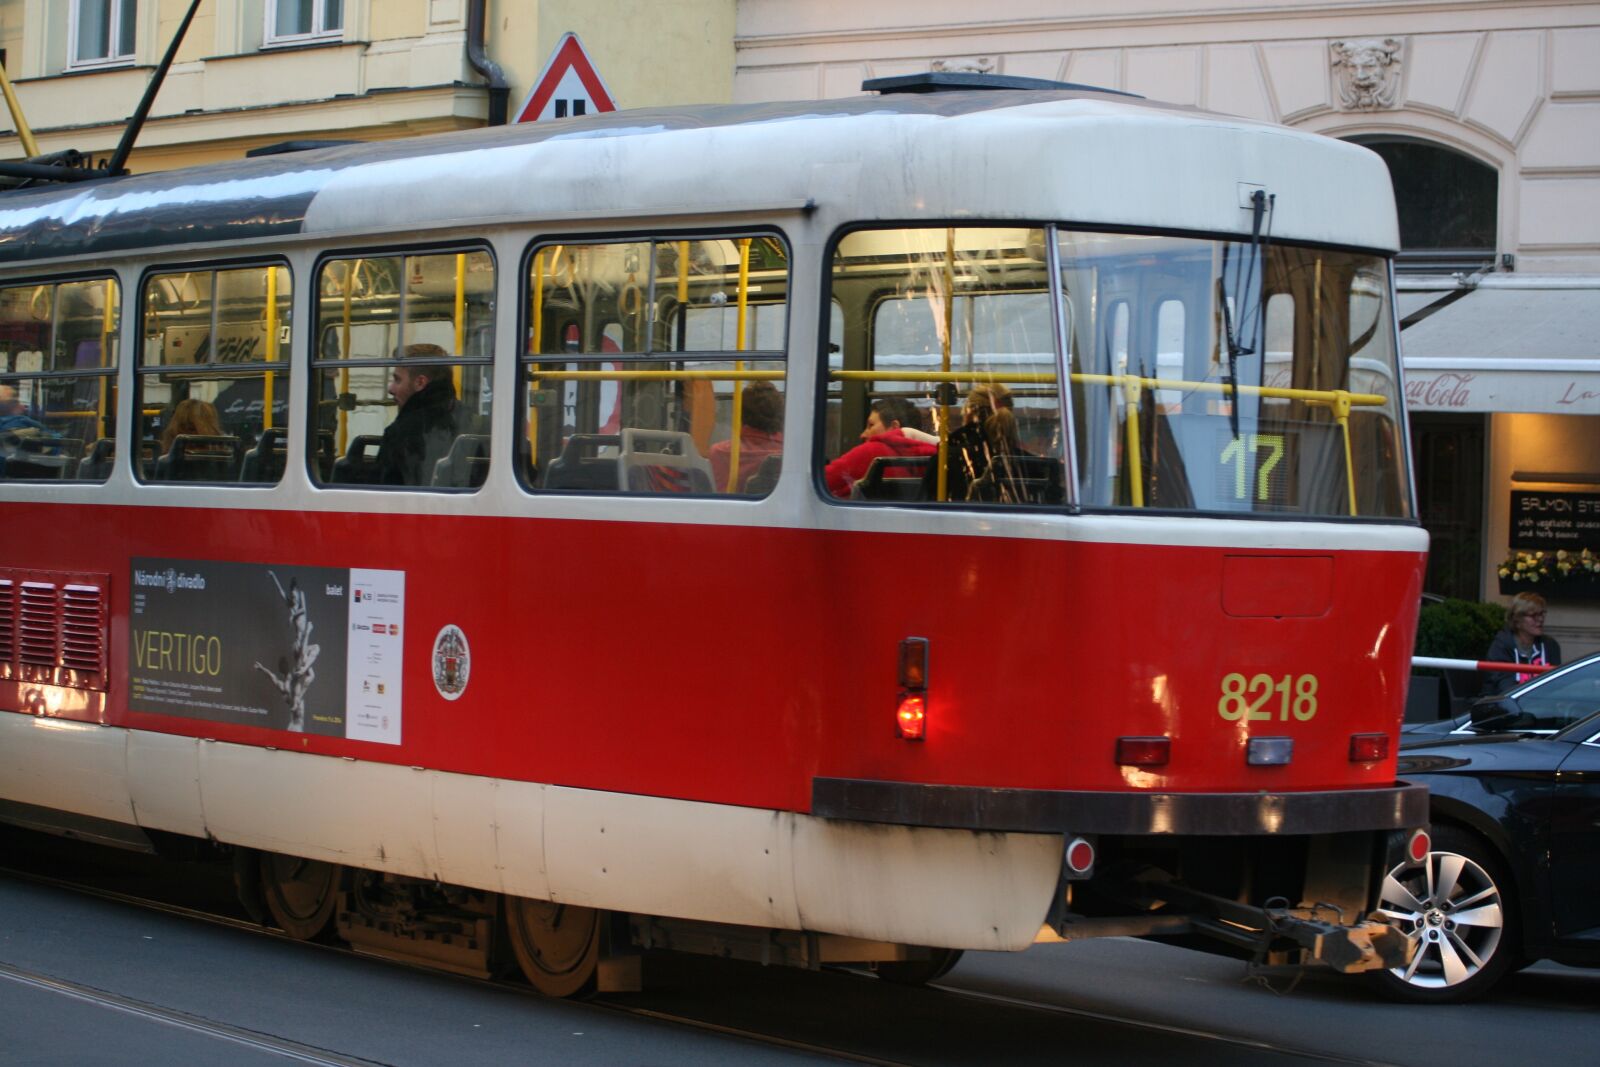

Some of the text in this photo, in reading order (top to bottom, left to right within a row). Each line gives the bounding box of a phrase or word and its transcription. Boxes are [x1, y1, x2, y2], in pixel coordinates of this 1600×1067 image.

[1405, 373, 1475, 407] ca-Cola
[1220, 434, 1284, 500] 17
[177, 572, 206, 590] divadlo
[326, 584, 343, 596] balet
[133, 629, 222, 676] VERTIGO
[1218, 672, 1319, 721] 8218
